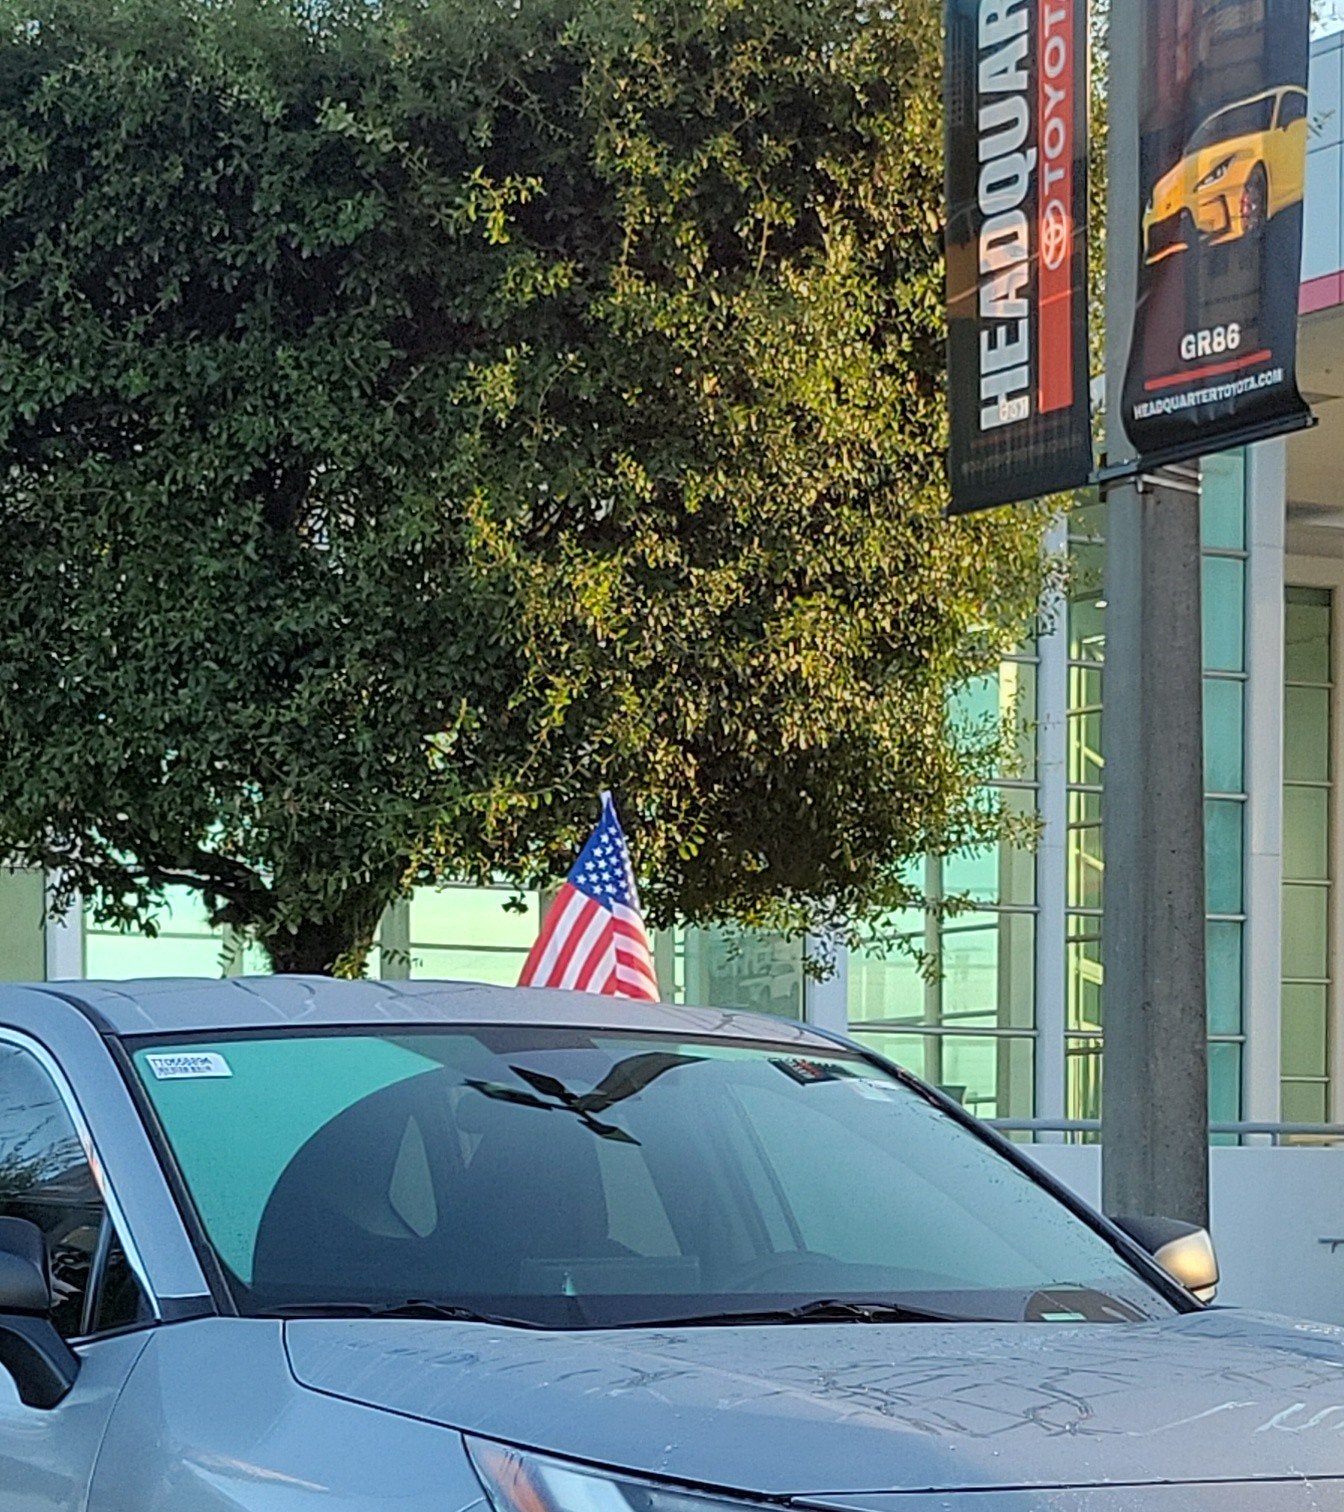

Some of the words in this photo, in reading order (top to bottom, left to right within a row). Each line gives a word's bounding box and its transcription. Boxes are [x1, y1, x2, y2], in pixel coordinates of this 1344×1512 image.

[1044, 0, 1067, 197] TOYOT
[1180, 322, 1241, 361] GR86
[1133, 367, 1284, 421] HEADQUARTERTOYOTA.COM
